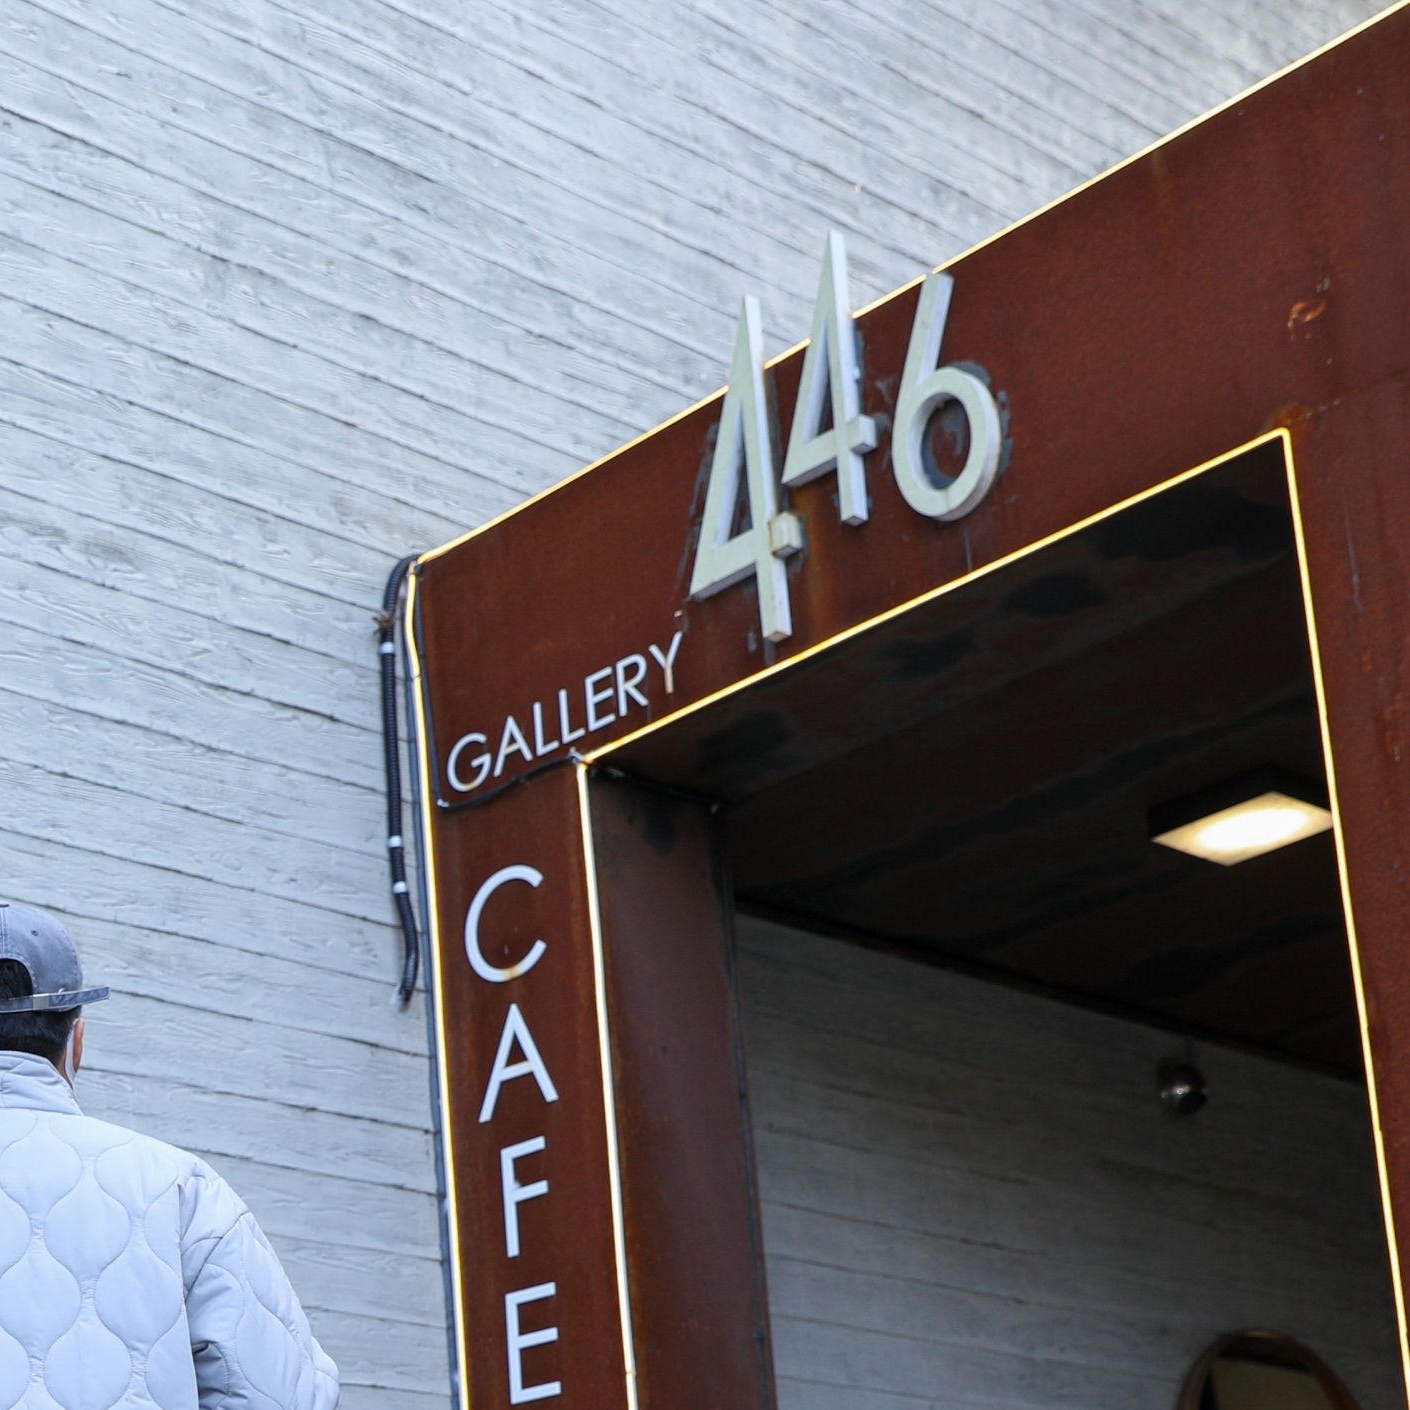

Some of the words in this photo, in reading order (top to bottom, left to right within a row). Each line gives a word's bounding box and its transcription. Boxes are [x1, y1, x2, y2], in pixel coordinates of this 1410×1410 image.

[447, 632, 683, 792] GALLERY
[690, 230, 1002, 642] 446
[465, 865, 562, 1405] CAFE
